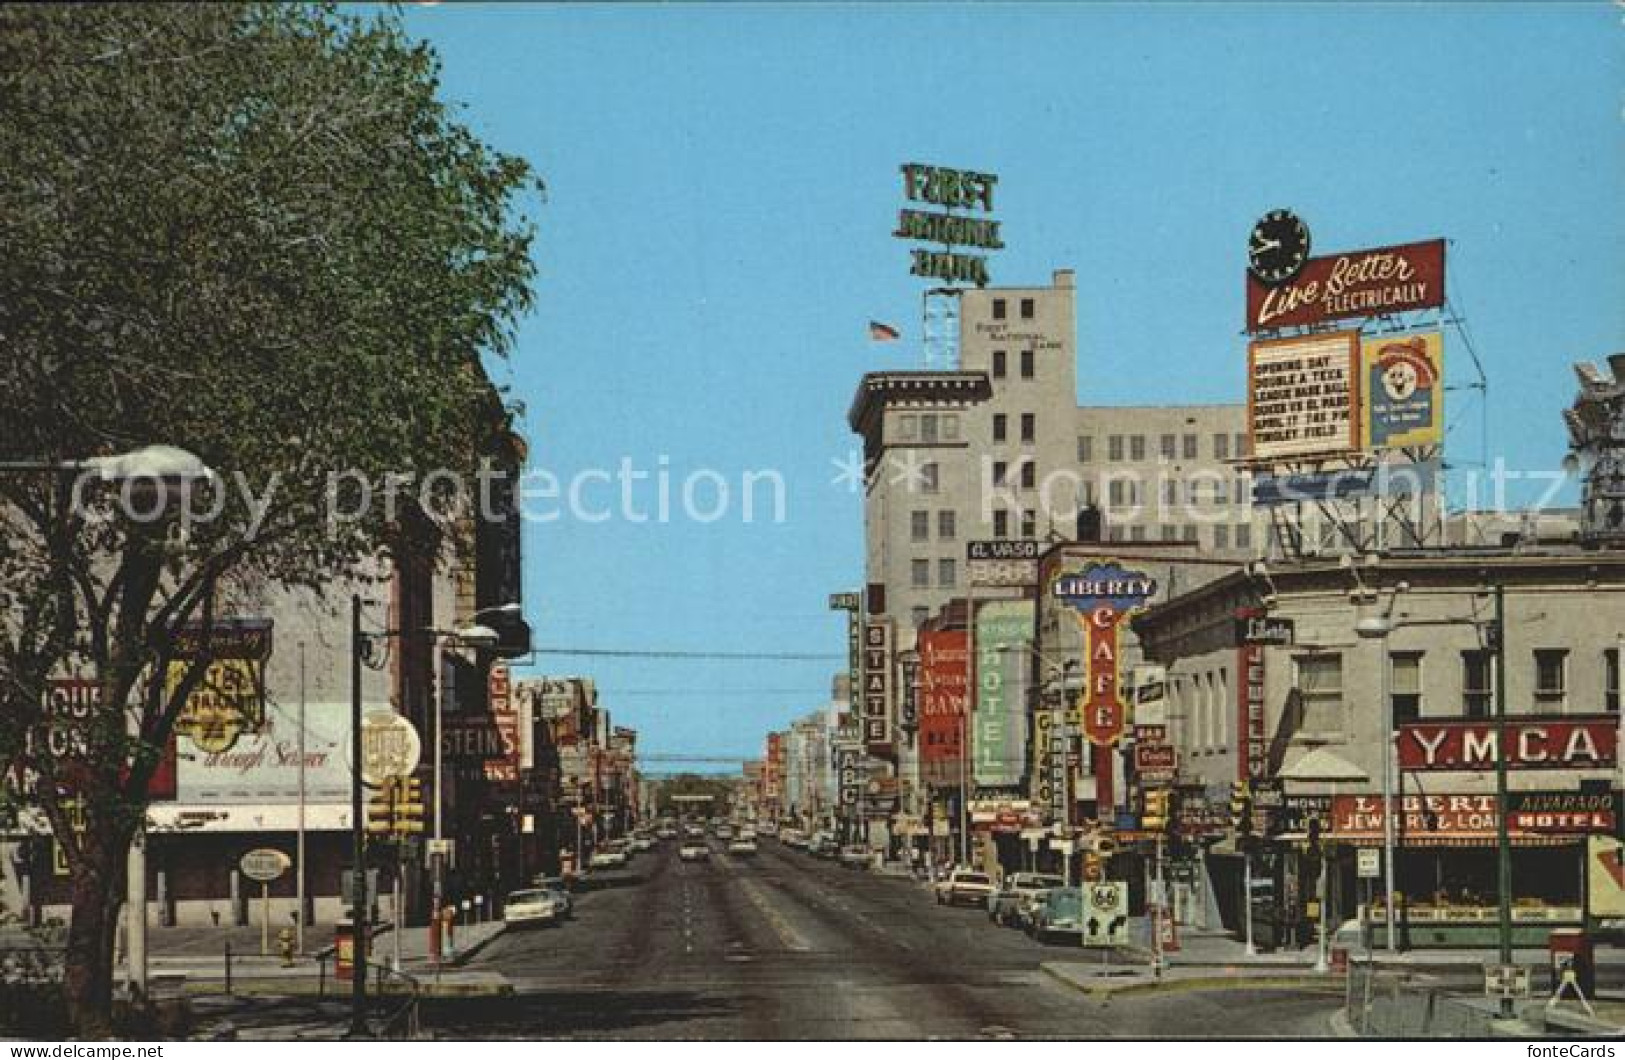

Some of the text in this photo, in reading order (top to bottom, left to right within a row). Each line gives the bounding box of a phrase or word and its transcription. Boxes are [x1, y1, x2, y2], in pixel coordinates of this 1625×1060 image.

[1258, 252, 1416, 325] Live Better
[1325, 282, 1428, 314] ELECTRICALLY
[1054, 580, 1154, 596] LIBERTY
[869, 628, 883, 737] STATE
[1093, 608, 1114, 727] CAFE
[983, 647, 1004, 767] HOTEL
[1517, 815, 1609, 827] HOTEL
[1521, 796, 1612, 811] ALVARADO
